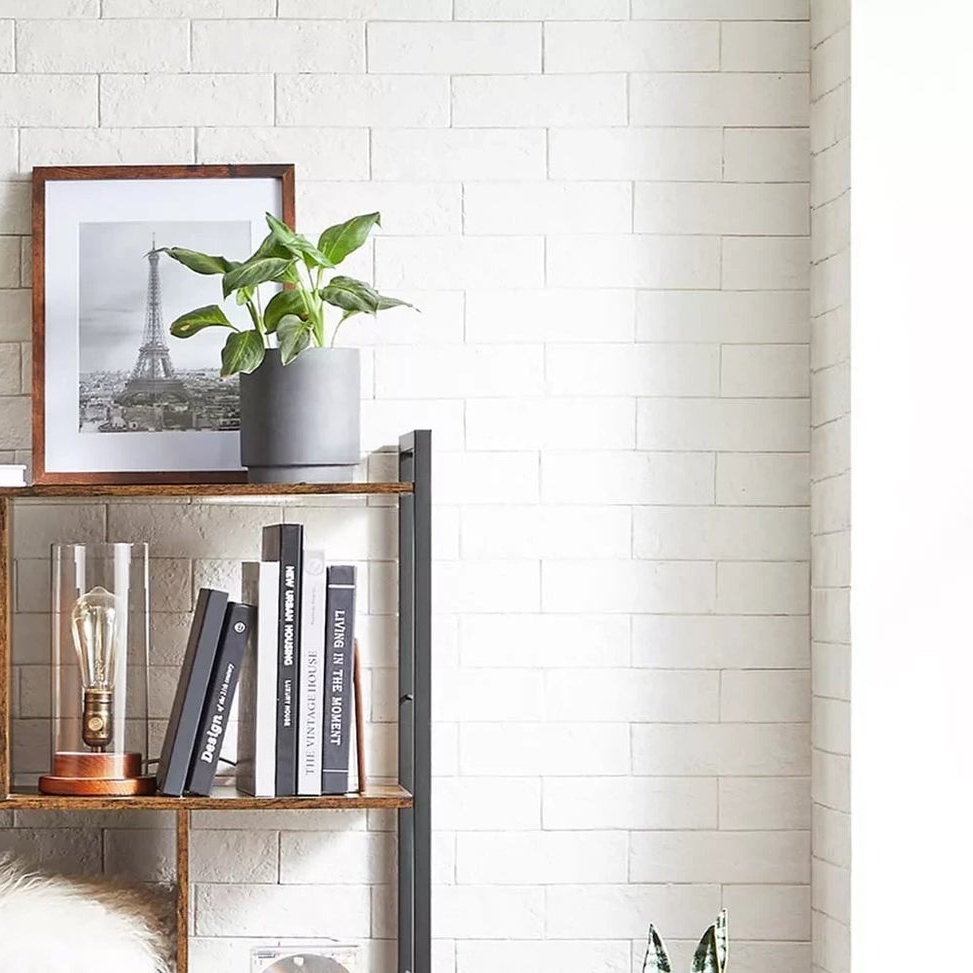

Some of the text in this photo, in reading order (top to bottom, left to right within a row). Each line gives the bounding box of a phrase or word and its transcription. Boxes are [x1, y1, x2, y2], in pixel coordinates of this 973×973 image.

[284, 566, 294, 666] NEW URBAN HOUSING
[306, 651, 318, 776] THE VINTAGE HOUSE
[330, 610, 346, 746] LIVING IN THE MOMENT
[201, 714, 223, 764] Design
